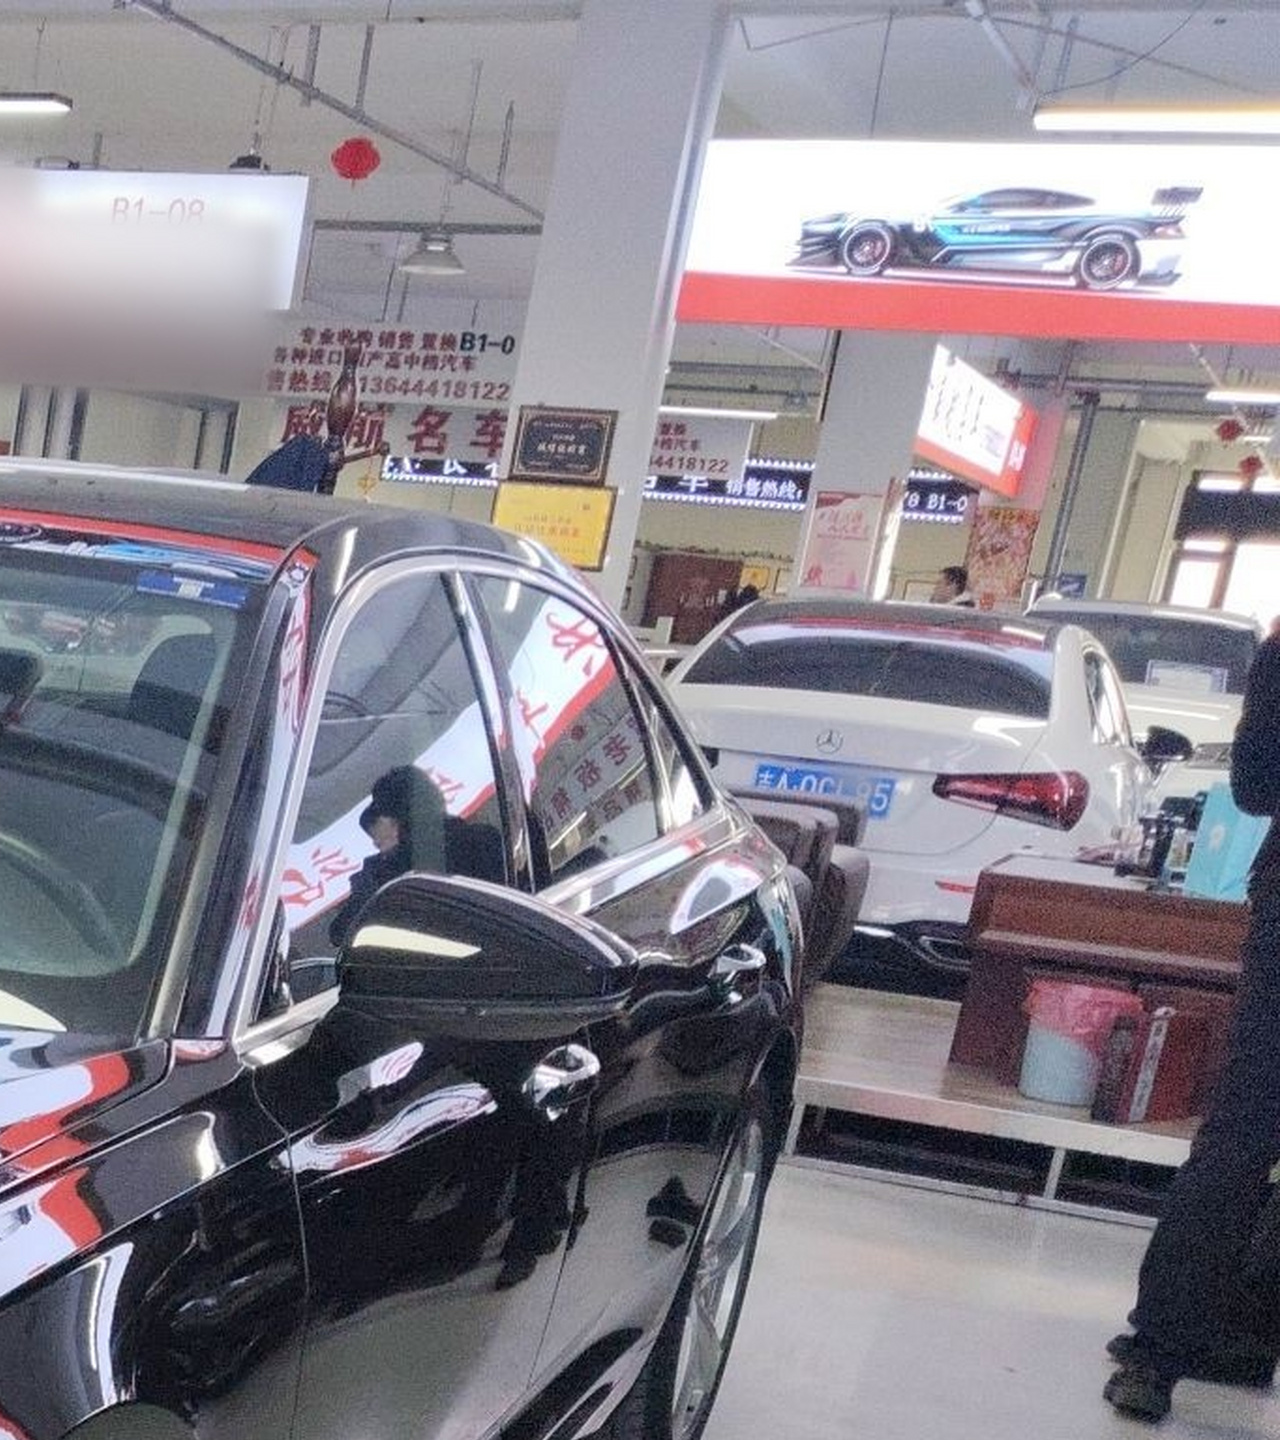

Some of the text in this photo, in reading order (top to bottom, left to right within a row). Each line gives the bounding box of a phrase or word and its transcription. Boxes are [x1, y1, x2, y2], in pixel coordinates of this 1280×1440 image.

[111, 197, 206, 226] B1-08
[273, 346, 477, 372] 各种进口产高中档汽车
[358, 376, 512, 401] 13644418122
